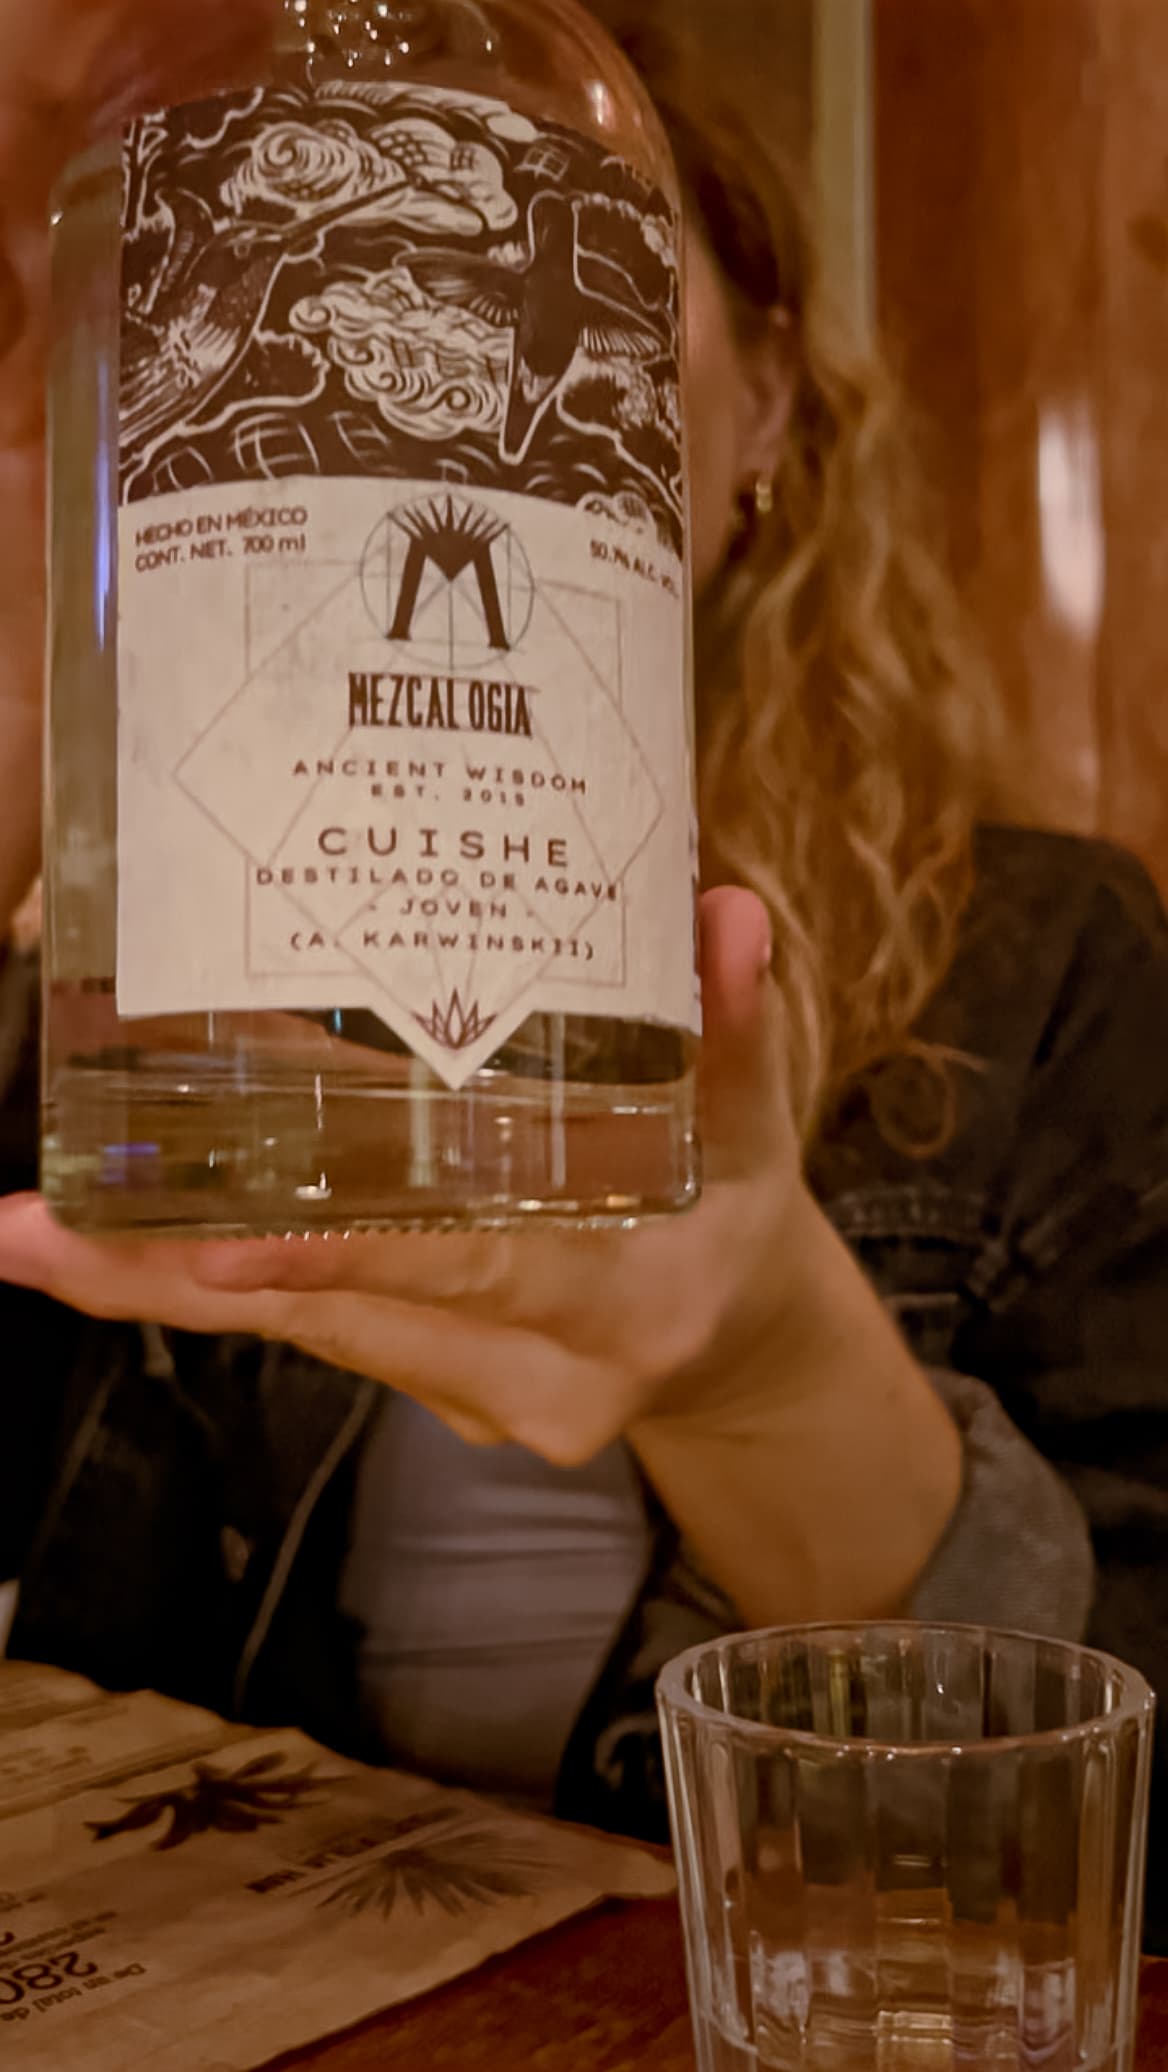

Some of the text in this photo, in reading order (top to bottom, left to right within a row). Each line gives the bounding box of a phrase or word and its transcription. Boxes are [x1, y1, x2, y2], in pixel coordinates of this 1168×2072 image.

[135, 505, 308, 546] HECHO EN MÉXICO
[134, 534, 306, 573] CONT. NET. 700 ml
[348, 671, 534, 738] MEZCALOGIA
[293, 759, 588, 795] ANCIENT WISDOM
[370, 784, 440, 801] EST.
[317, 826, 568, 868] CUISHE
[256, 866, 617, 901] DESTILADO DE AGAVE
[400, 899, 507, 919] JOVEN
[363, 931, 594, 960] KARWINSKII)
